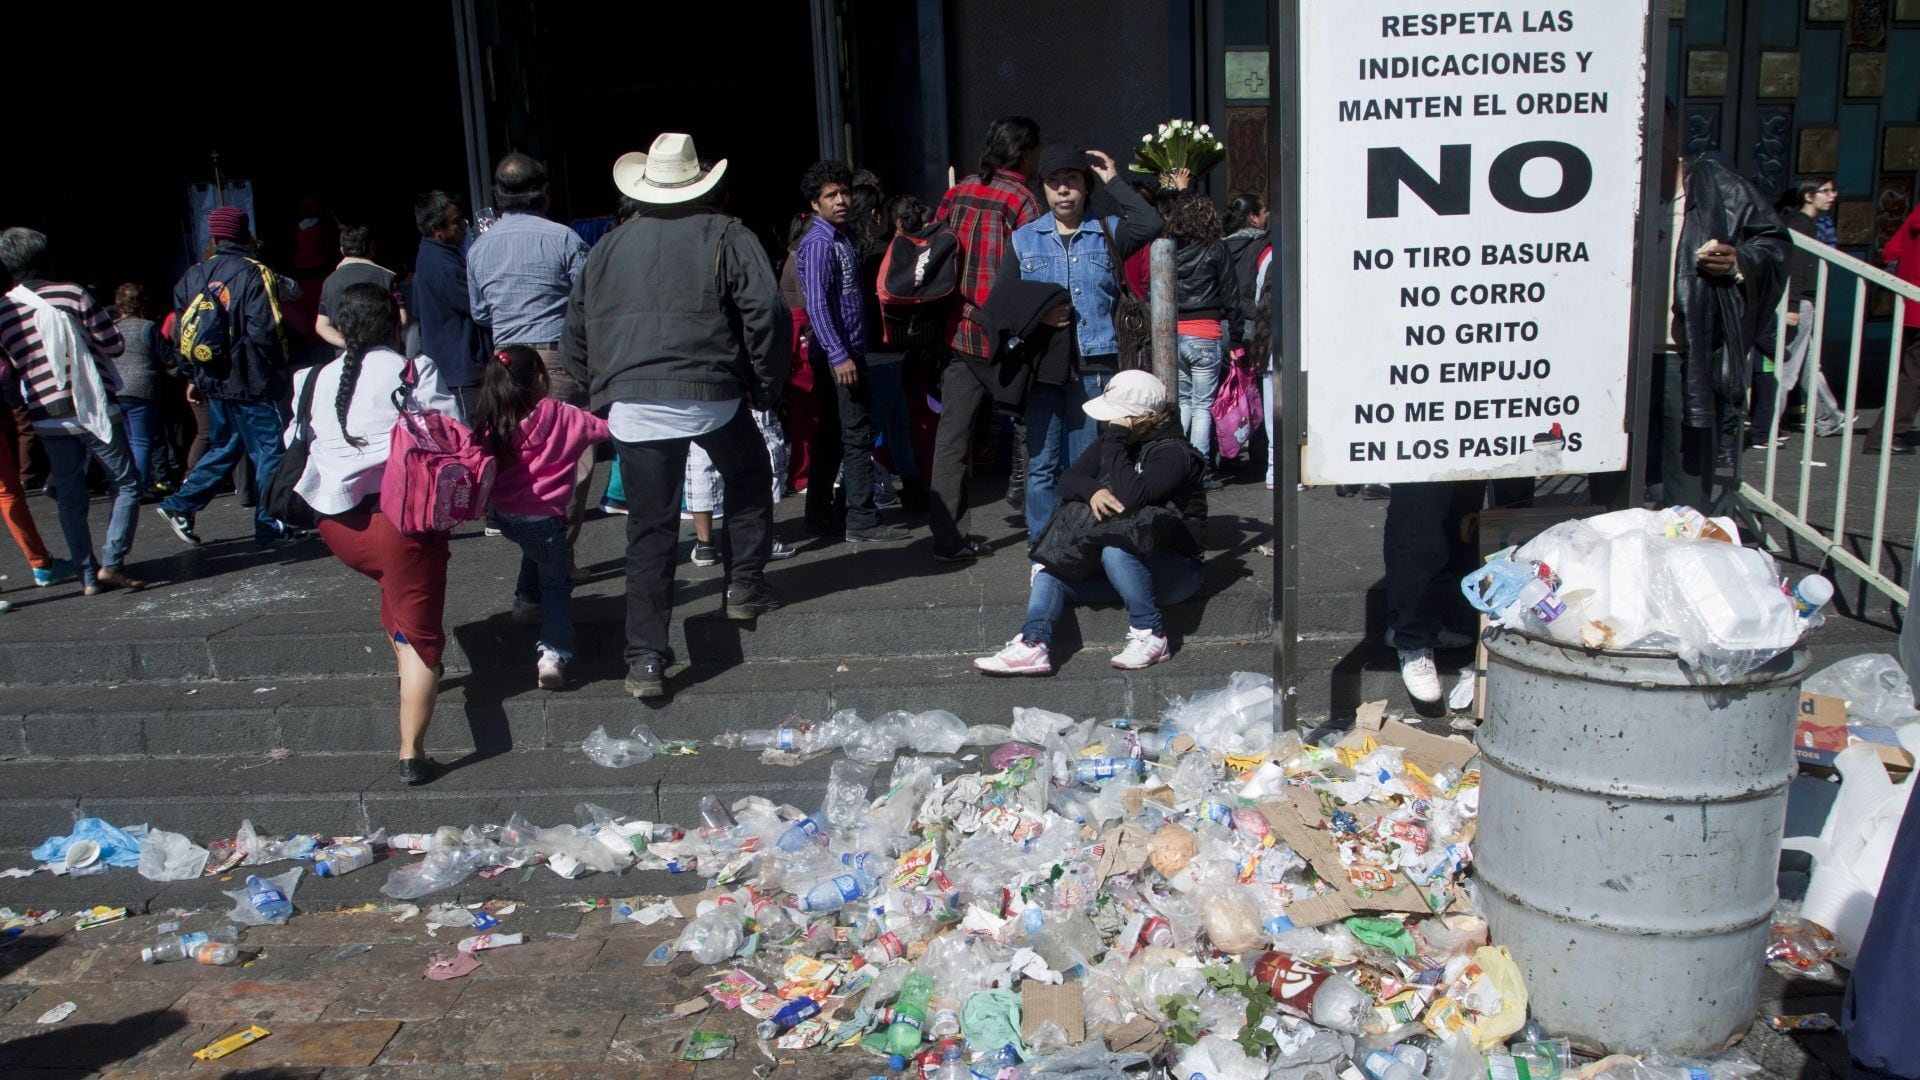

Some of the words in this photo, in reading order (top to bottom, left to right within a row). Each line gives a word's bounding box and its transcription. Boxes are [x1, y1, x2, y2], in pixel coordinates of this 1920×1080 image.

[1382, 11, 1513, 38] RESPETA
[1522, 10, 1574, 33] LAS
[1359, 51, 1566, 80] INDICACIONES
[1575, 51, 1593, 73] Y
[1339, 95, 1463, 122] MANTEN
[1473, 94, 1507, 116] EL
[1516, 91, 1608, 115] ORDEN
[1366, 140, 1593, 219] NO
[1353, 248, 1394, 271] NO
[1403, 245, 1471, 269] TIRO
[1481, 241, 1590, 266] BASURA
[1400, 285, 1441, 308] NO
[1450, 281, 1546, 306] CORRO
[1405, 324, 1446, 347] NO
[1455, 320, 1539, 345] GRITO
[1389, 363, 1430, 385] NO
[1439, 358, 1551, 384] EMPUJO
[1355, 403, 1395, 425] NO
[1405, 401, 1445, 423] ME
[1454, 394, 1580, 421] DETENGO
[1349, 441, 1386, 462] EN
[1396, 438, 1449, 461] LOS
[1459, 432, 1583, 458] PASILS
